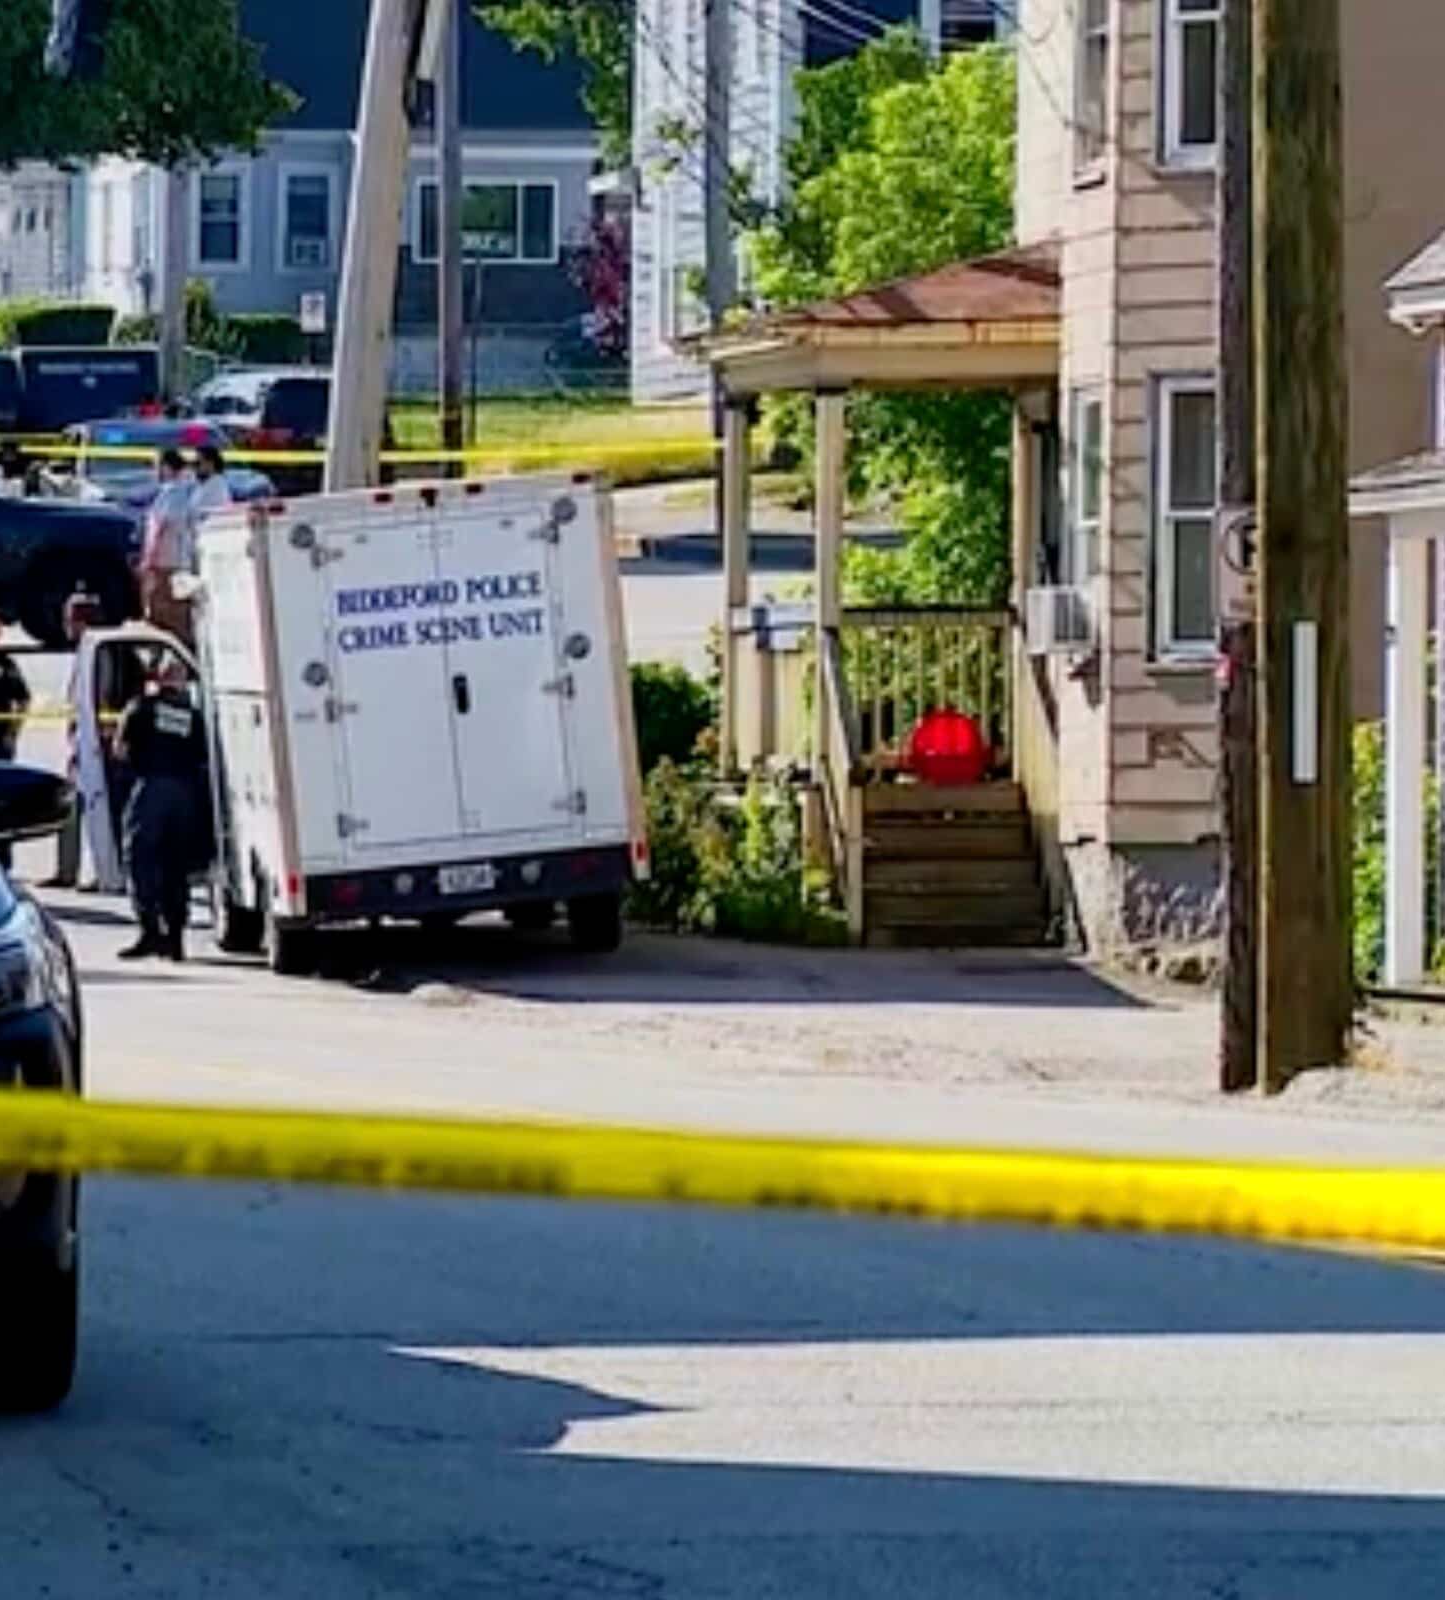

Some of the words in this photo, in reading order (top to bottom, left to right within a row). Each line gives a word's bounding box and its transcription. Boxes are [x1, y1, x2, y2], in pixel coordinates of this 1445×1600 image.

[338, 581, 458, 616] BIDDEFORD
[467, 572, 540, 602] POLICE
[339, 623, 409, 653] CRIME
[416, 616, 482, 645] SCENE
[489, 608, 543, 637] UNIT
